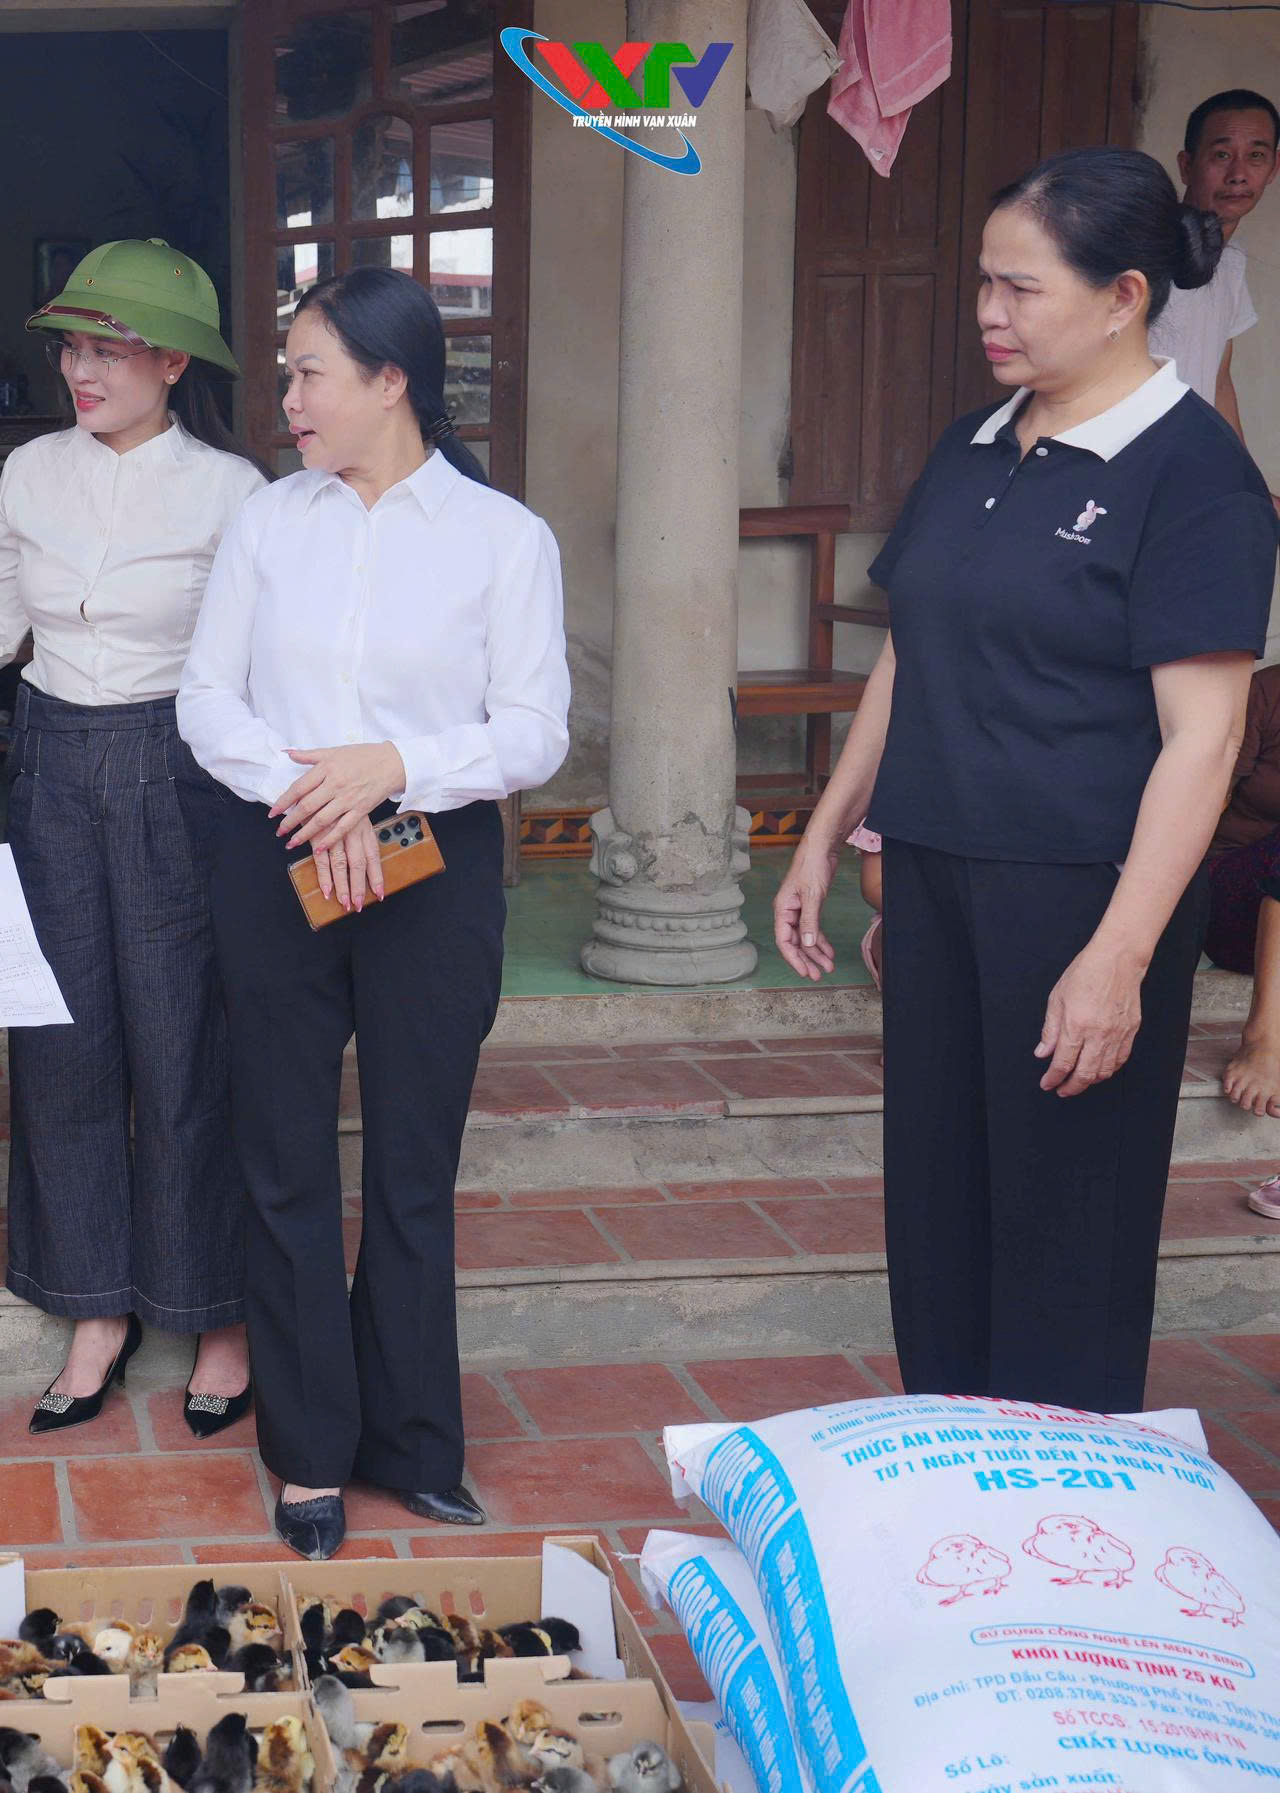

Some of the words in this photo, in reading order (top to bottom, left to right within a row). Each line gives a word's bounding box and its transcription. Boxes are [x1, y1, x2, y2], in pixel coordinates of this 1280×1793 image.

[1040, 1430, 1086, 1443] CHO
[904, 1460, 915, 1473] 1
[921, 1448, 977, 1471] NGÀY
[1082, 1450, 1109, 1464] 14
[973, 1468, 1137, 1492] HS-201
[974, 1674, 1006, 1689] TPD
[1182, 1667, 1206, 1684] 25
[1210, 1674, 1236, 1691] KG
[944, 1755, 972, 1779] Số
